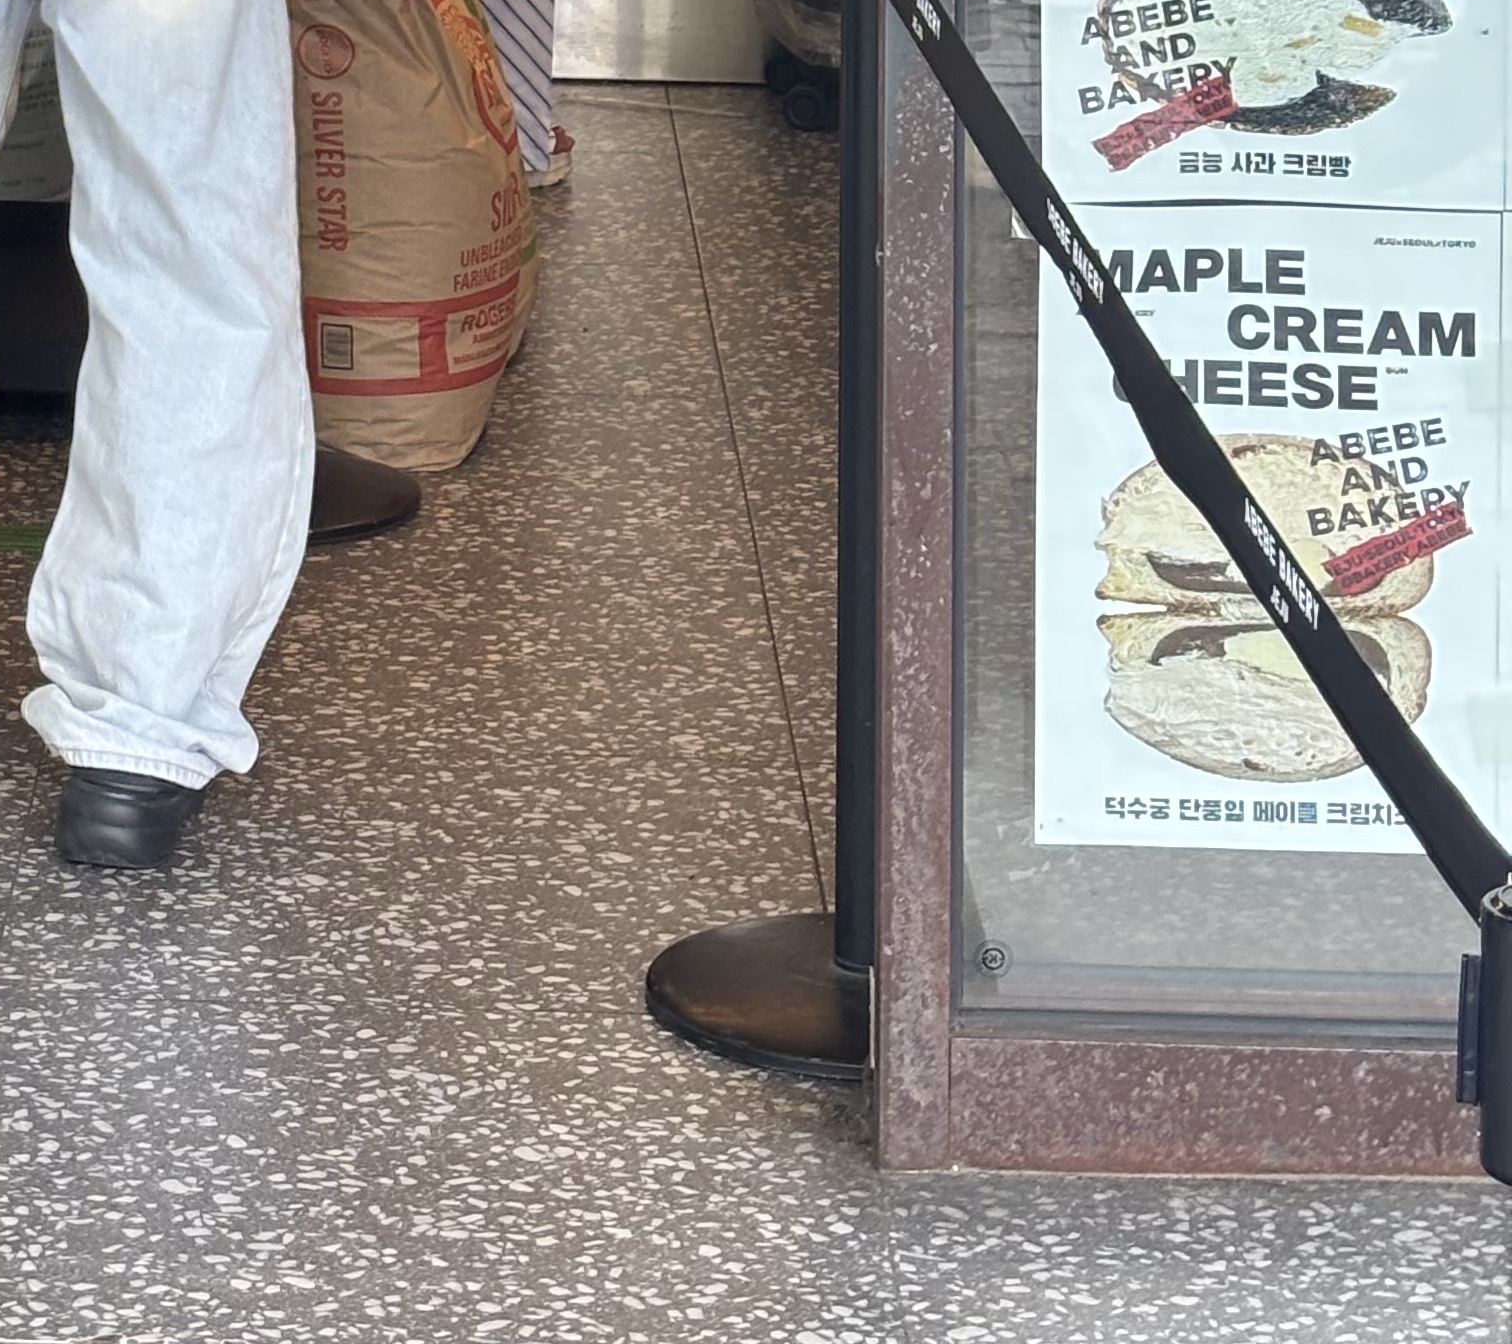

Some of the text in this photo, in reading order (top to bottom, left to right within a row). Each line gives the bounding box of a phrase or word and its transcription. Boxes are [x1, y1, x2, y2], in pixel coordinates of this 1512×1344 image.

[1110, 33, 1196, 74] AND
[1078, 57, 1237, 115] BAKERY
[311, 91, 346, 179] SILVER
[1178, 152, 1352, 178] 금능 사과 크림빵
[316, 187, 349, 253] STAR
[1094, 248, 1306, 296] MAPLE
[1227, 303, 1477, 358] CREAM
[1112, 359, 1378, 411] HEESE
[1310, 417, 1447, 467] ABEBE
[1340, 457, 1429, 497] AND
[1306, 480, 1470, 537] BAKERY
[1243, 497, 1320, 631] ABEBE BAKERY
[1105, 796, 1170, 820] 덕수궁
[1253, 800, 1318, 824] 메이플
